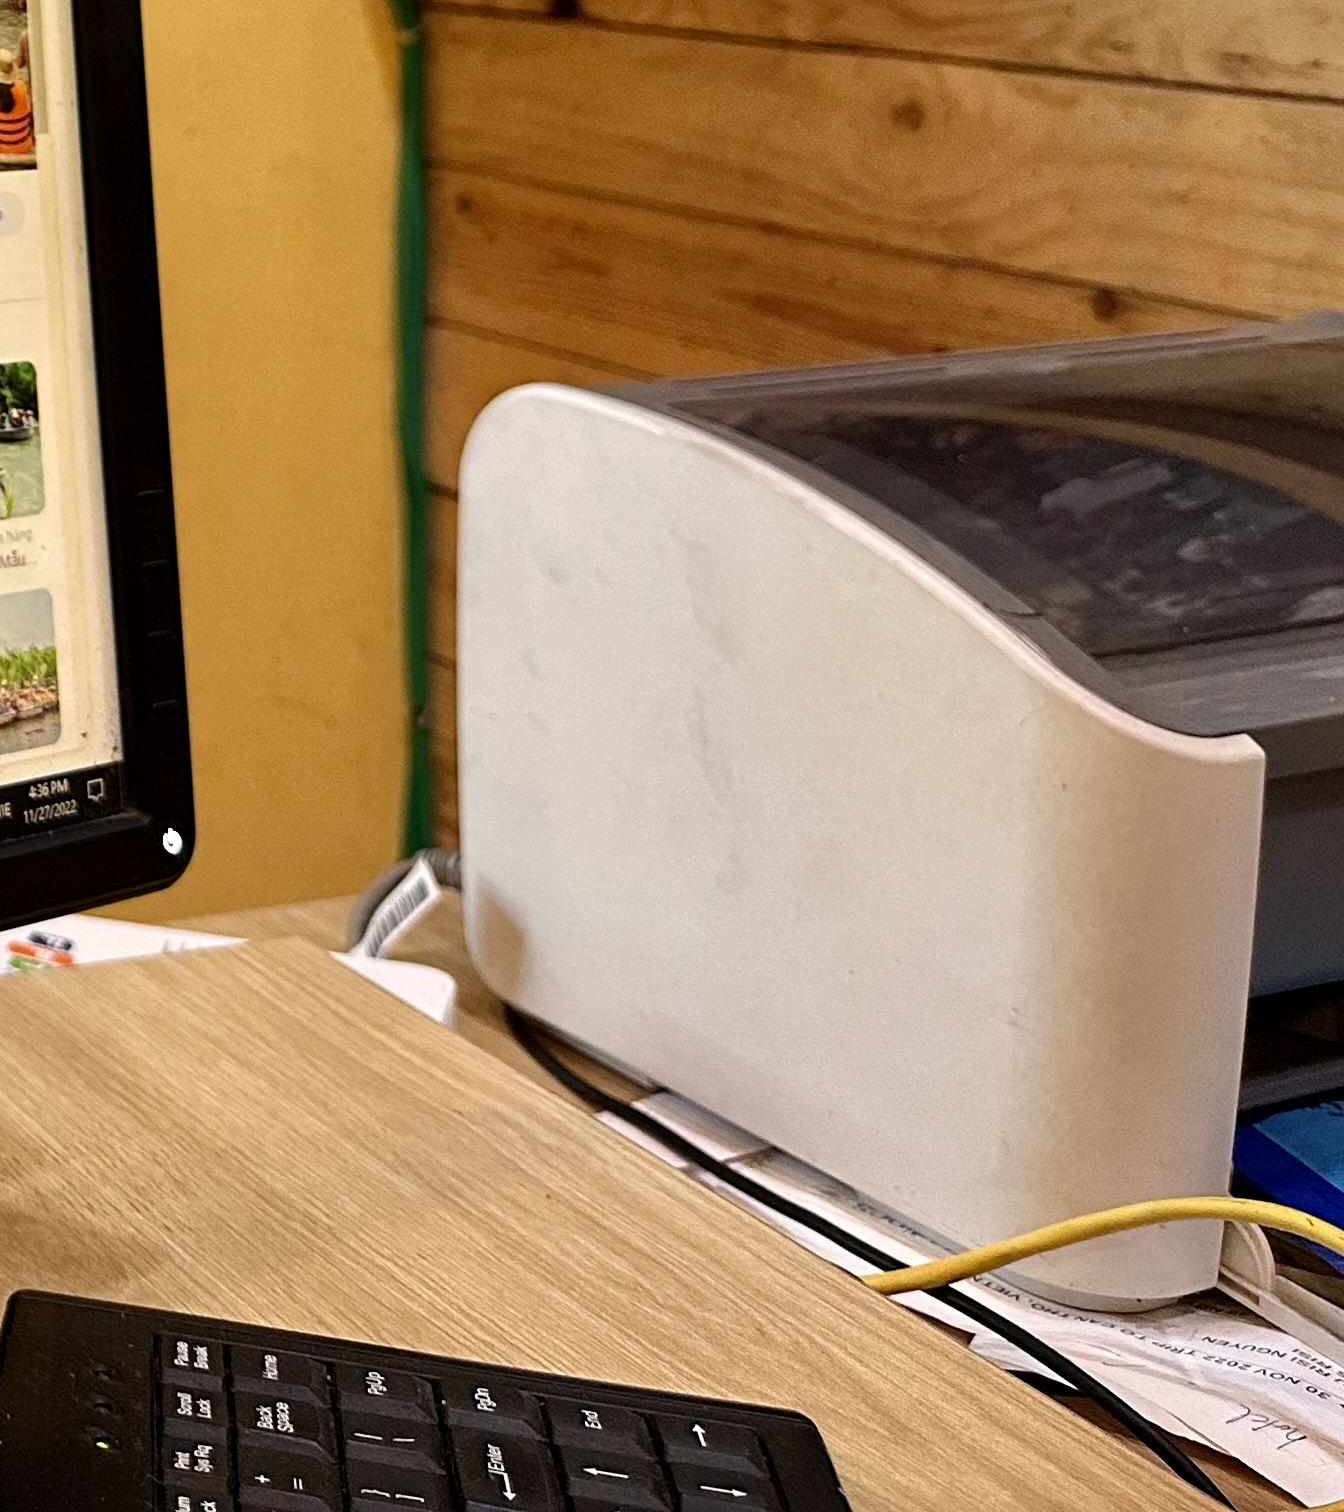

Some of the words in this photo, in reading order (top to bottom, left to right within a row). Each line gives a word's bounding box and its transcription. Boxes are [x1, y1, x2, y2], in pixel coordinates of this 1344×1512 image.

[50, 778, 69, 794] PM
[23, 799, 78, 824] 11/27/2022
[1074, 1316, 1115, 1328] CAN
[1120, 1328, 1146, 1341] TO
[174, 1341, 189, 1367] Pause
[193, 1345, 209, 1370] Break
[1152, 1341, 1195, 1356] TRIP
[1202, 1336, 1287, 1358] NGUYEN
[262, 1355, 278, 1381] Home
[1203, 1355, 1251, 1371] 2022
[365, 1371, 387, 1396] PgUp
[1254, 1368, 1300, 1385] NOV
[474, 1388, 497, 1412] PgDn
[1306, 1386, 1332, 1400] 30
[177, 1392, 192, 1417] Scroll
[196, 1398, 212, 1419] Lock
[256, 1405, 274, 1430] Back
[276, 1402, 294, 1433] Space
[581, 1409, 602, 1430] End
[174, 1451, 191, 1470] Print
[488, 1444, 505, 1472] Enter
